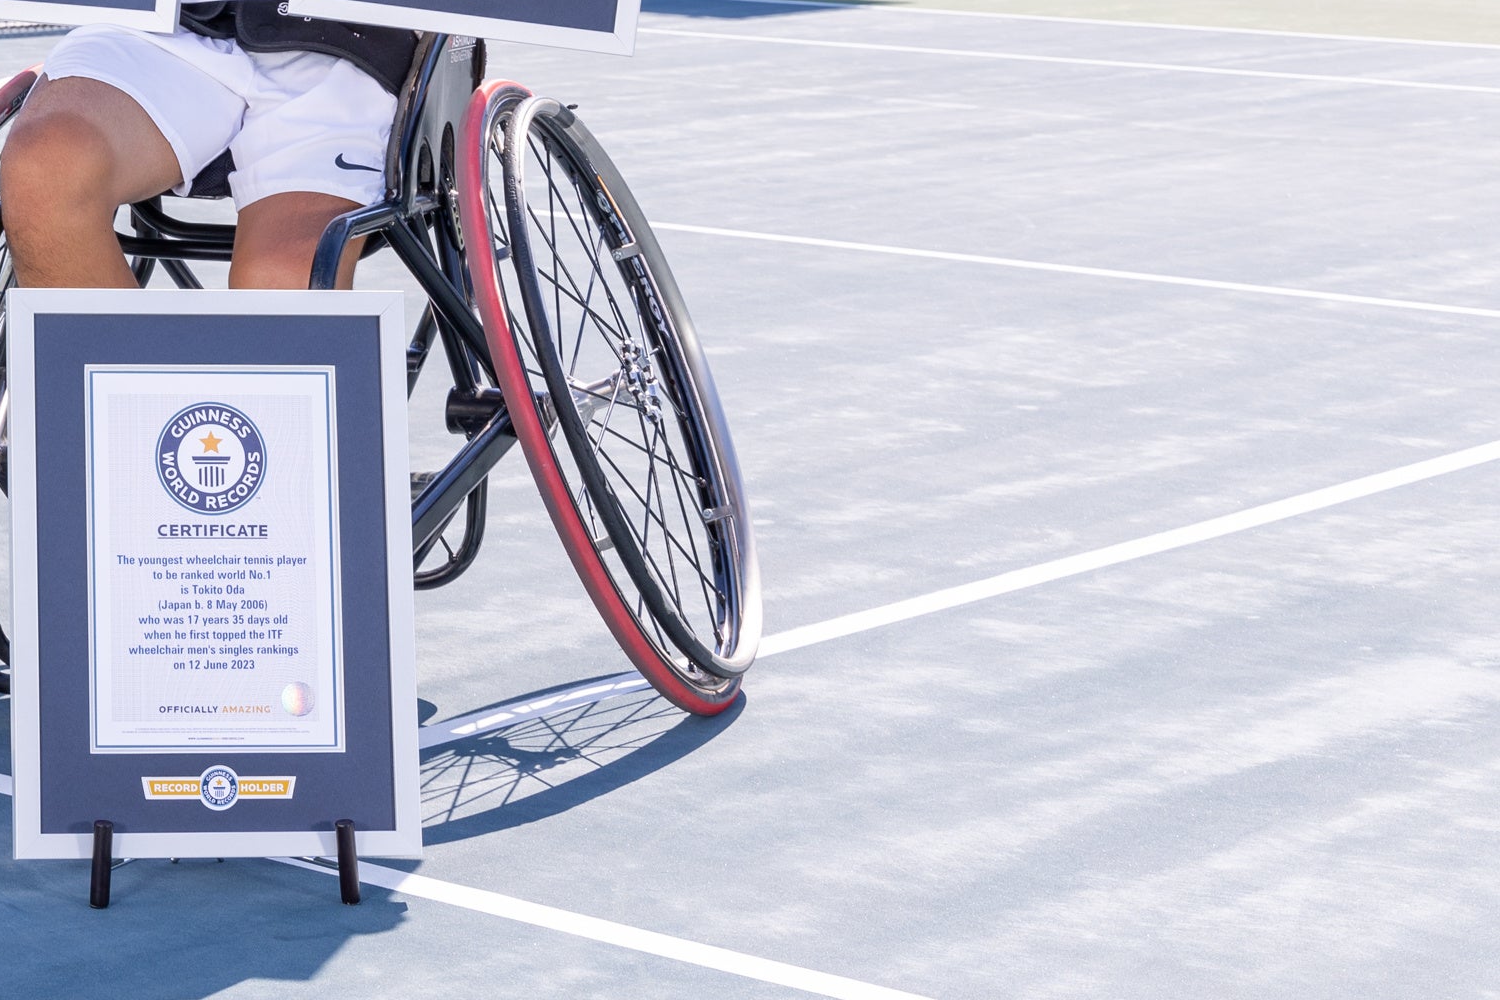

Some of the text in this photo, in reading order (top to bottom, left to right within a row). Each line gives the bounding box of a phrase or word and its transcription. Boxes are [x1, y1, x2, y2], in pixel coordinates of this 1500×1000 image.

[171, 409, 251, 438] GUINNESS
[162, 451, 260, 509] WORLD RECORDS
[157, 524, 268, 537] CERTIFICATE
[116, 554, 307, 567] The youngest wheelchair tennis player
[153, 571, 163, 580] to
[165, 569, 178, 580] be
[180, 569, 215, 580] ranked
[217, 569, 246, 580] world
[180, 584, 245, 595] is Tokito Oda
[158, 599, 268, 612] (Japan b. 8 May 2006)
[138, 614, 288, 627] who was 17 years 35 days old
[143, 629, 283, 642] when he first topped the ITF
[128, 644, 299, 657] wheelchair men's singles rankings
[173, 659, 255, 670] on 12 June 2023
[158, 705, 271, 714] OFFICIALLY AMAZING
[154, 783, 284, 793] RECORD HOLDER
